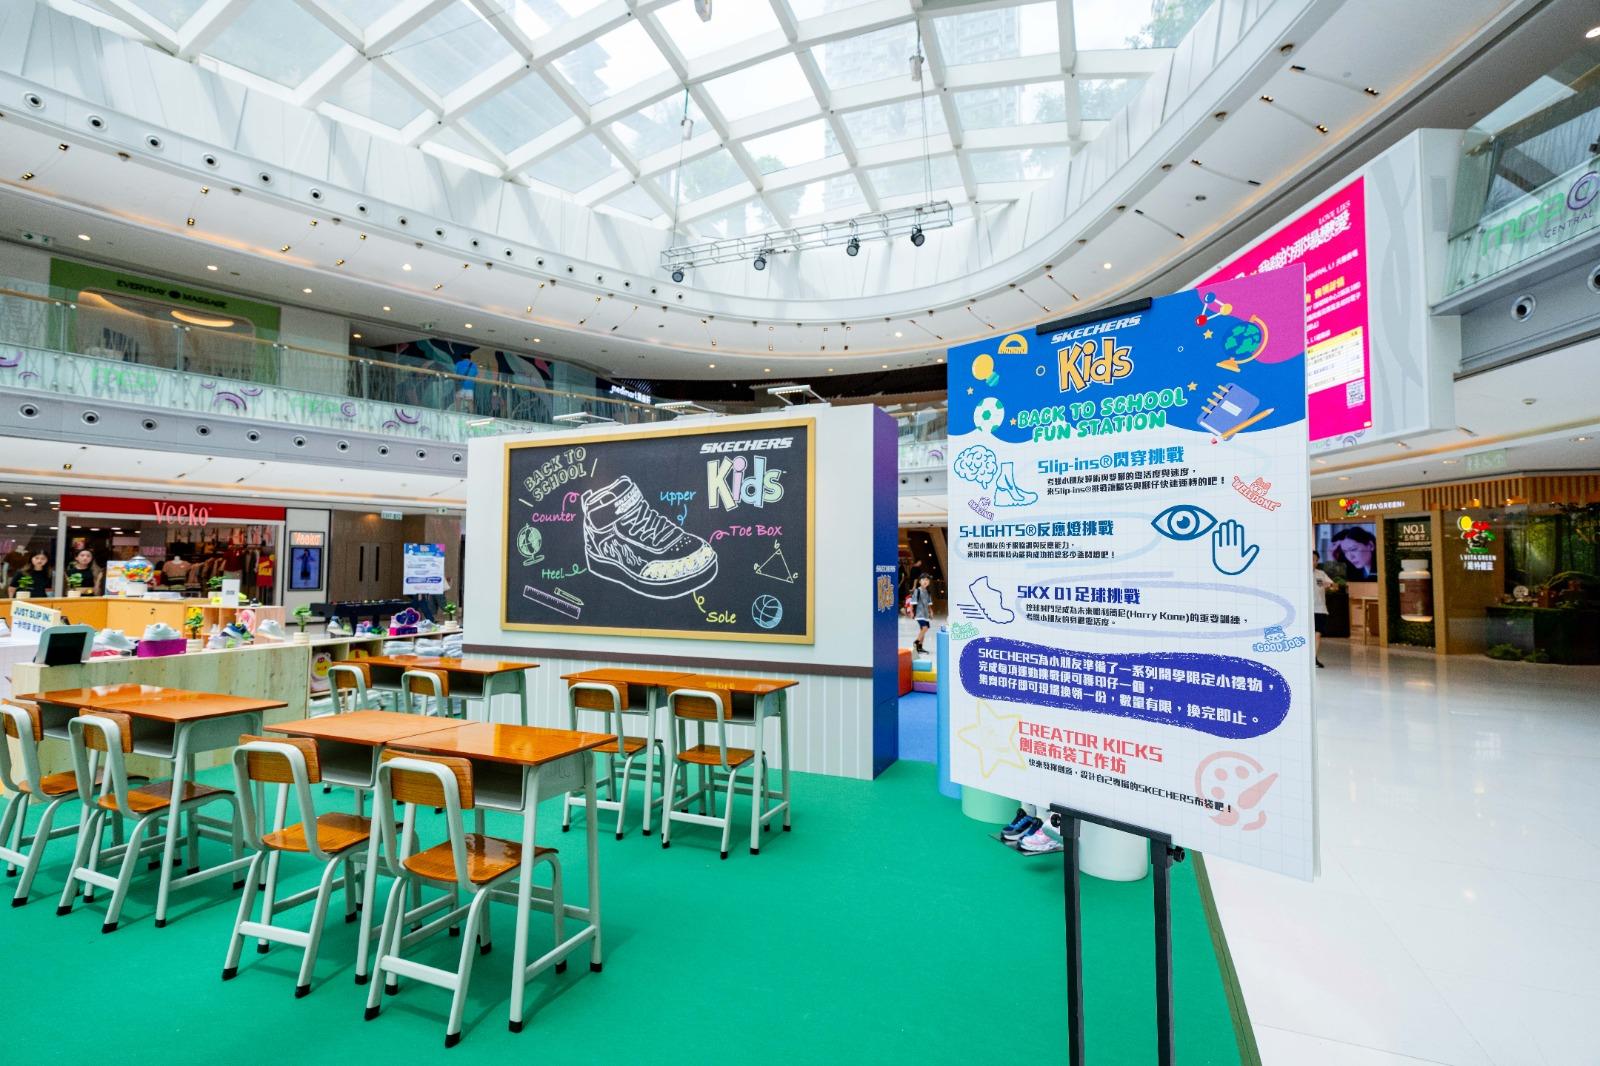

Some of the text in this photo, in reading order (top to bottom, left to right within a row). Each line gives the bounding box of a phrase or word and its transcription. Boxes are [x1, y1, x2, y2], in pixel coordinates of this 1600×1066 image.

[1544, 211, 1594, 238] CENTRAL
[1050, 314, 1142, 344] SKECHERS
[1058, 336, 1133, 393] Kids
[1017, 386, 1188, 429] BACK TO SCHOOL
[1032, 410, 1167, 444] FUN STATION
[700, 436, 794, 454] SKECHERS
[523, 446, 587, 493] BACK TO
[532, 462, 588, 502] SCHOOL
[707, 455, 786, 512] Kids
[154, 501, 209, 526] Veeko
[532, 511, 576, 524] Counter
[729, 524, 783, 537] Toe Box
[541, 568, 565, 580] Heel
[1017, 585, 1050, 601] SKX
[706, 610, 736, 625] Sole
[1256, 642, 1283, 652] GOOD
[1018, 720, 1163, 763] CREATOR KICKS
[1019, 736, 1126, 775] 創意布袋工作坊
